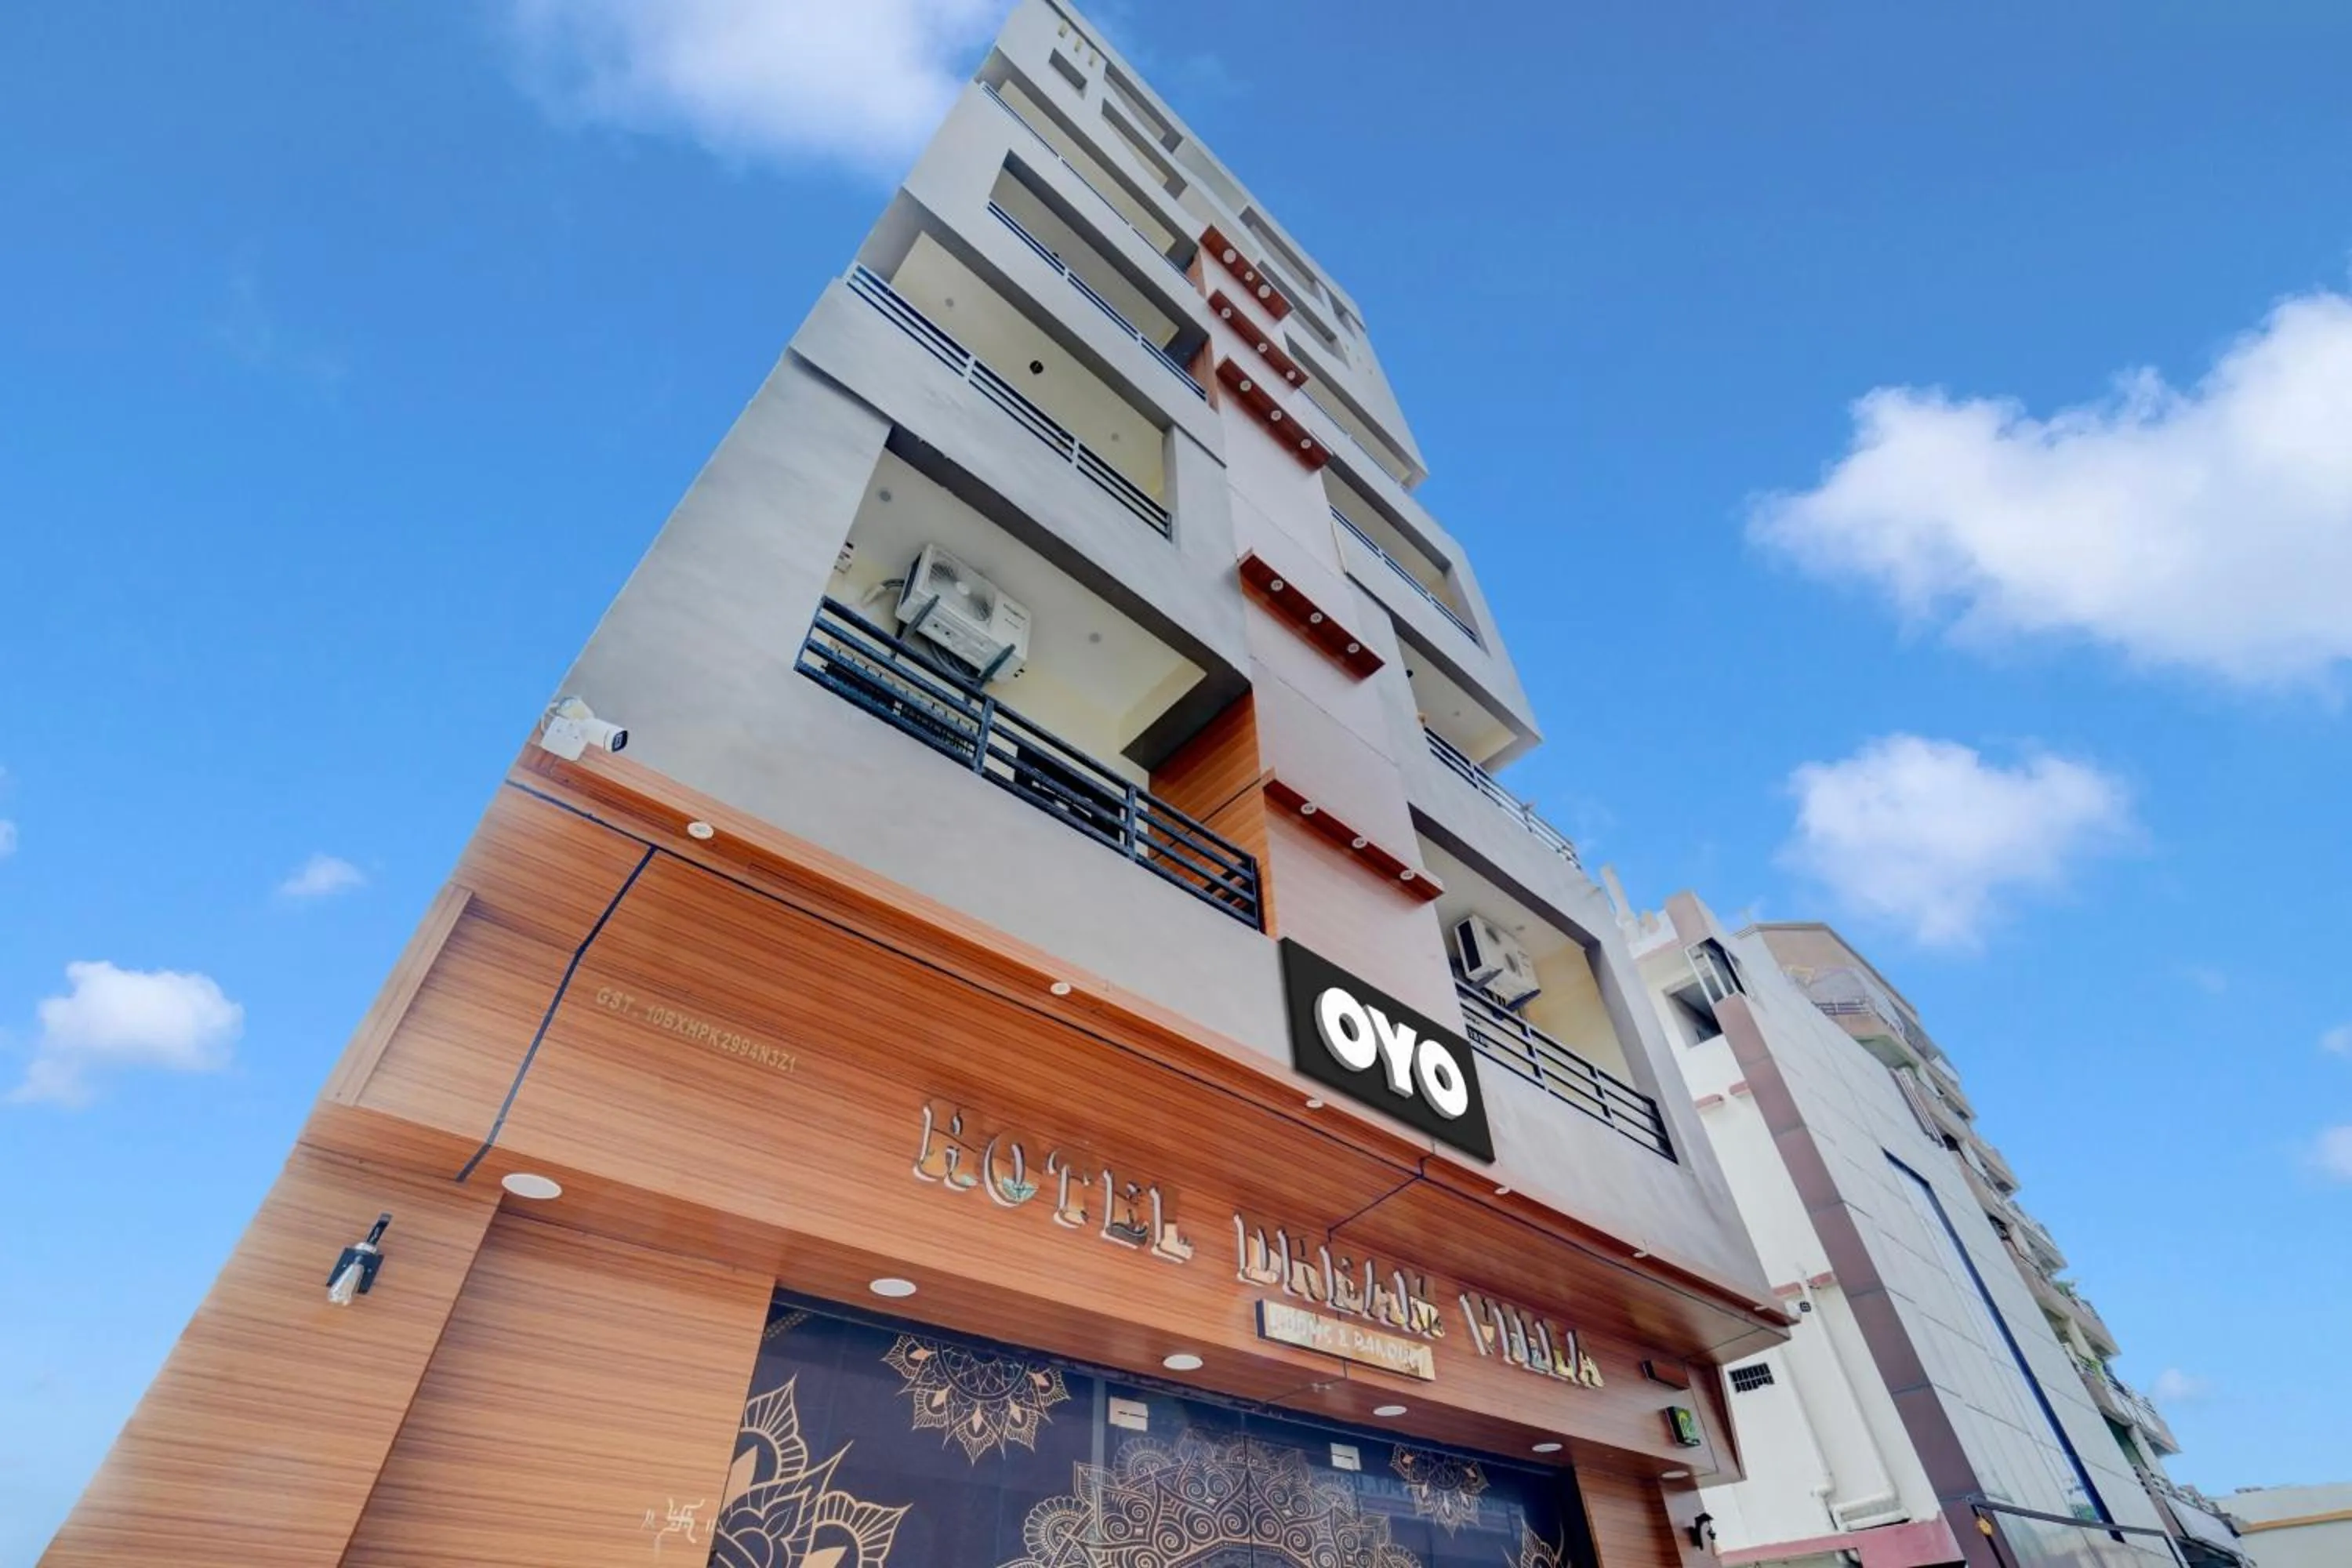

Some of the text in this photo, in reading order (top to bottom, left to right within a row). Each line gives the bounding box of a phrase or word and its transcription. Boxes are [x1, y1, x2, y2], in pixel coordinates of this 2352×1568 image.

[1314, 986, 1468, 1120] OYO
[913, 1099, 1605, 1389] HOTEL DREAM VILLA
